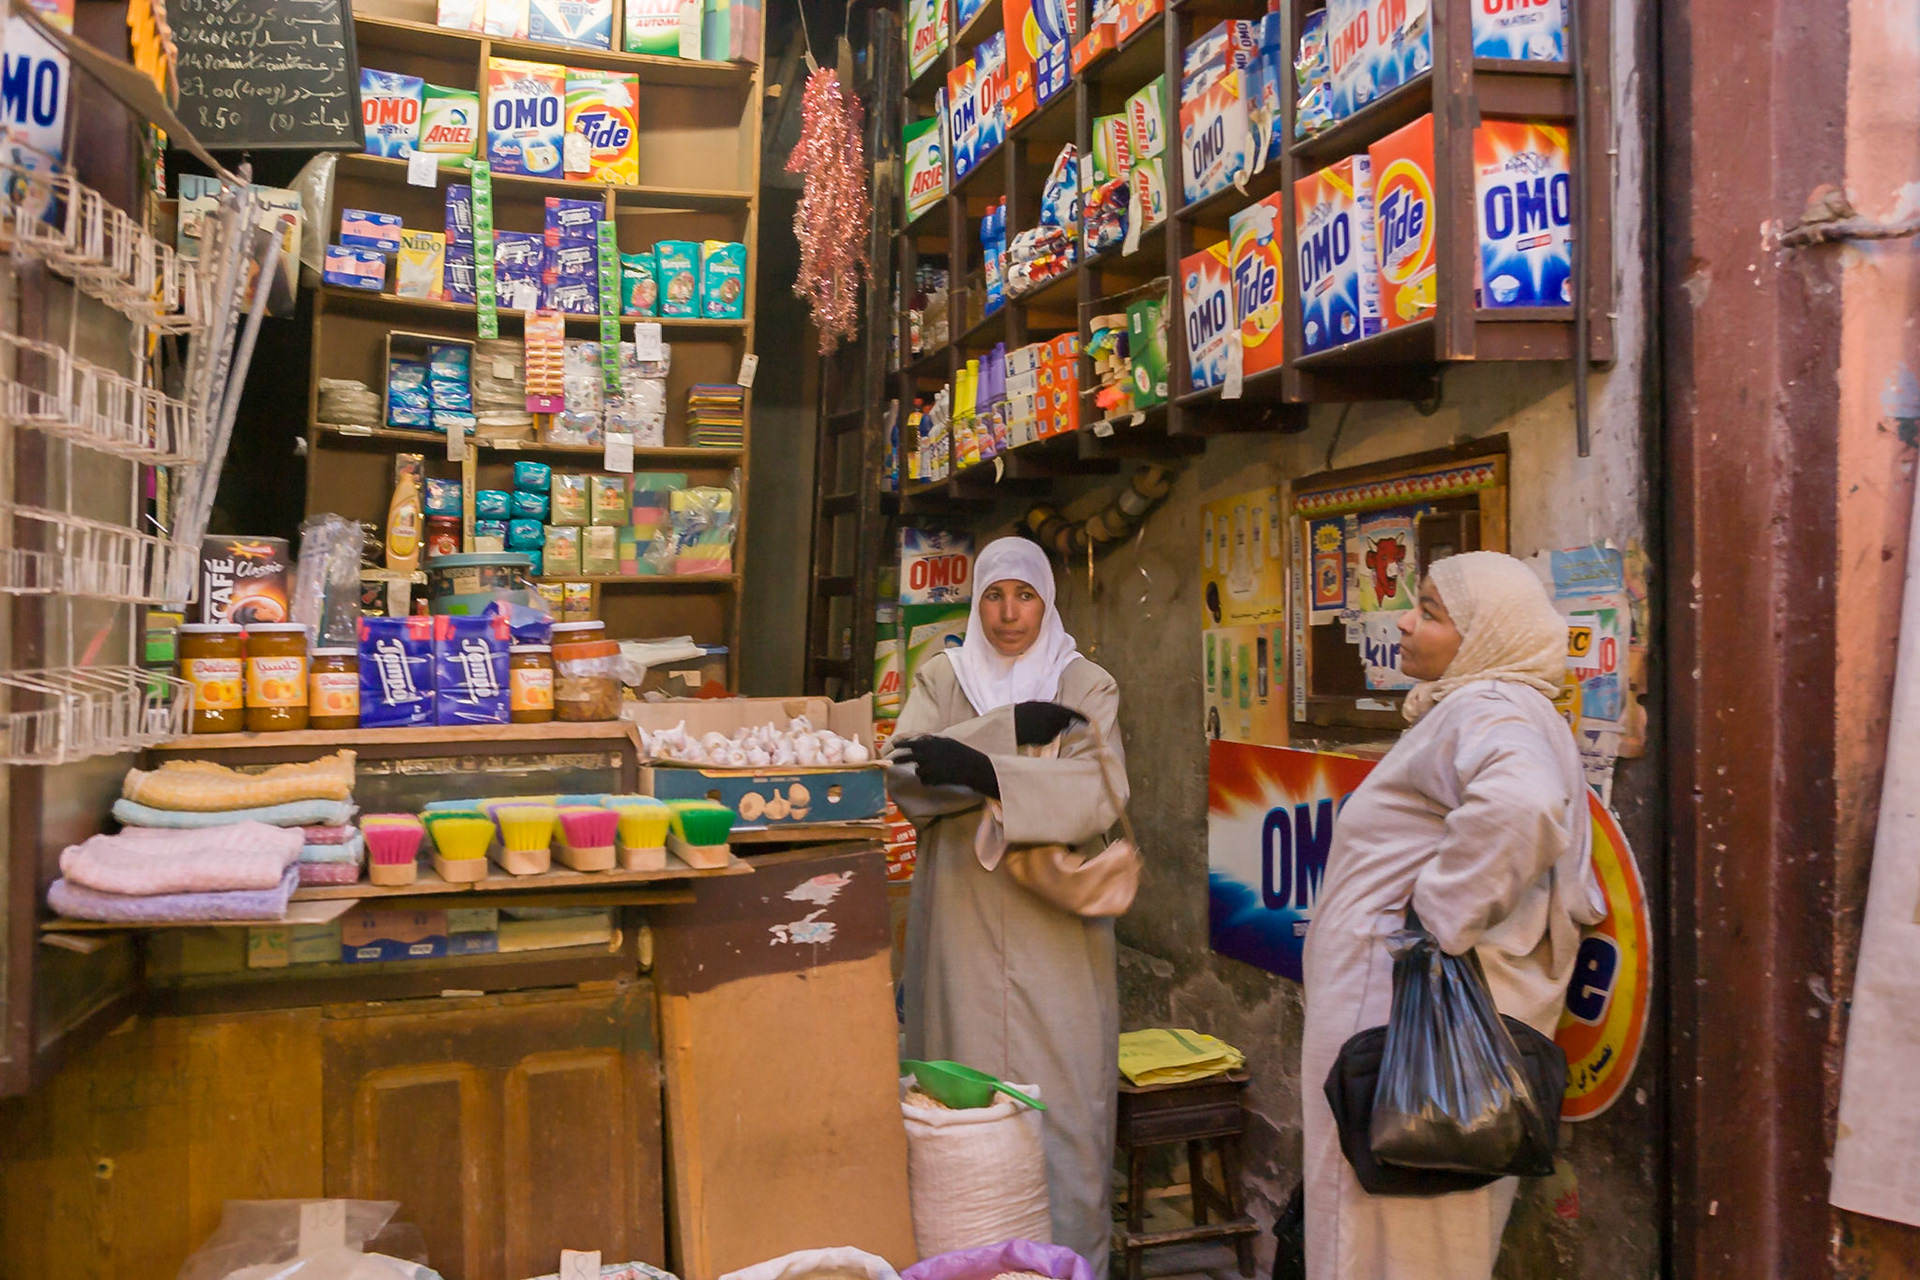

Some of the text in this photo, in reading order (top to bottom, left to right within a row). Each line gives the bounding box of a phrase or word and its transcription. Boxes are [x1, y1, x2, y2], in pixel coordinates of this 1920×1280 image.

[1236, 22, 1252, 47] OMO
[1332, 10, 1368, 75] OMO
[362, 98, 418, 125] OMO
[424, 125, 472, 143] ARIEL
[494, 97, 558, 130] OMO
[576, 113, 629, 148] Tide
[1134, 100, 1149, 150] ARIEL
[1193, 115, 1224, 179] OMO
[1379, 188, 1424, 269] Tide
[1484, 172, 1570, 241] OMO
[400, 236, 442, 252] NIDO
[1301, 212, 1350, 292] OMO
[1189, 289, 1226, 352] OMO
[1234, 255, 1276, 329] Tide
[204, 555, 235, 624] CAFÉ
[909, 555, 968, 590] OMO
[372, 638, 417, 707] Tempo
[459, 638, 500, 704] Tempo
[1262, 792, 1353, 910] OM
